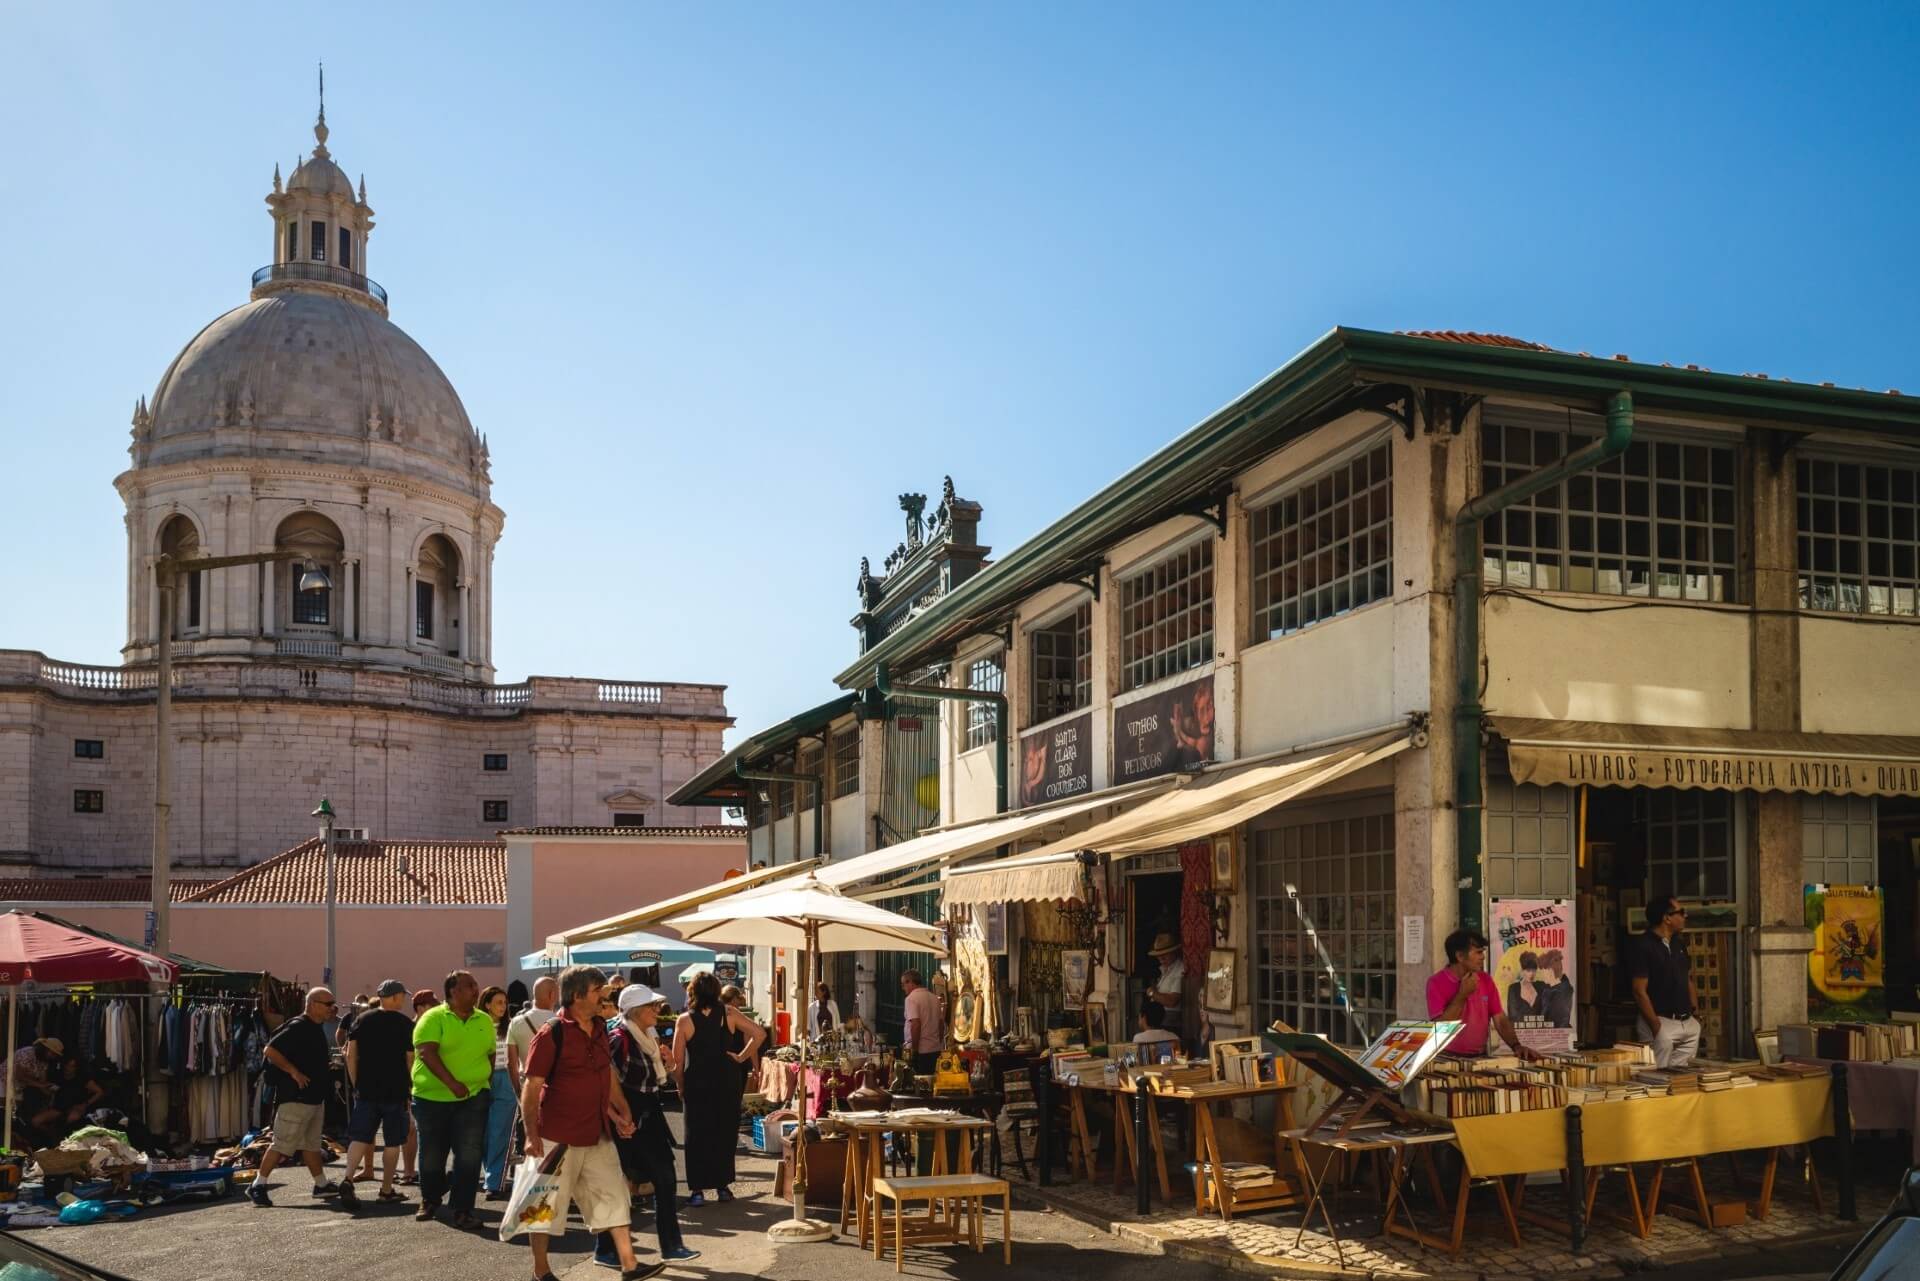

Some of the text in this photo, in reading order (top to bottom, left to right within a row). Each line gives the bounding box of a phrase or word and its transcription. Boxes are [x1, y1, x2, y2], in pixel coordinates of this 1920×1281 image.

[1127, 714, 1158, 737] VINHOS
[1055, 727, 1077, 747] SANTA
[1138, 737, 1145, 753] E
[1054, 744, 1077, 763] CLARA
[1124, 751, 1162, 775] PETISCOS
[1058, 762, 1073, 779] DOS
[1568, 754, 1637, 781] LIVROS
[1664, 757, 1775, 786] FOTOGRAFIA
[1789, 762, 1852, 789] ANTIGA
[1824, 887, 1877, 899] GUATEMALA
[1520, 905, 1555, 921] SEM
[1499, 915, 1564, 939] SOMBRA
[1507, 935, 1528, 948] DE
[1529, 928, 1565, 949] PECADO
